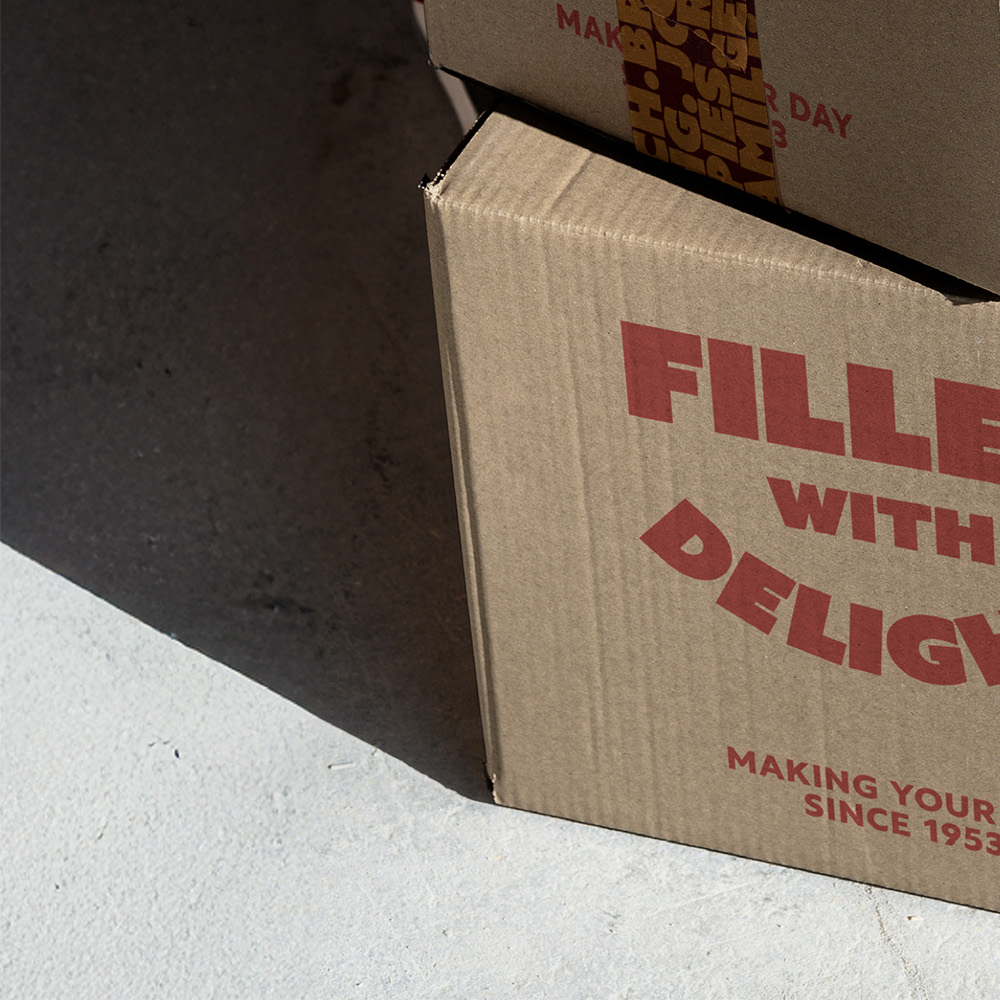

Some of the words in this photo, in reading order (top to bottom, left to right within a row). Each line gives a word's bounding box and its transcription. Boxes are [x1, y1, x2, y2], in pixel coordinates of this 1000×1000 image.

[556, 2, 624, 52] MAK
[789, 91, 853, 139] DAY
[766, 476, 995, 566] WITH
[727, 746, 878, 799] MAKING
[889, 780, 997, 825] YOUR
[804, 793, 911, 837] SINCE
